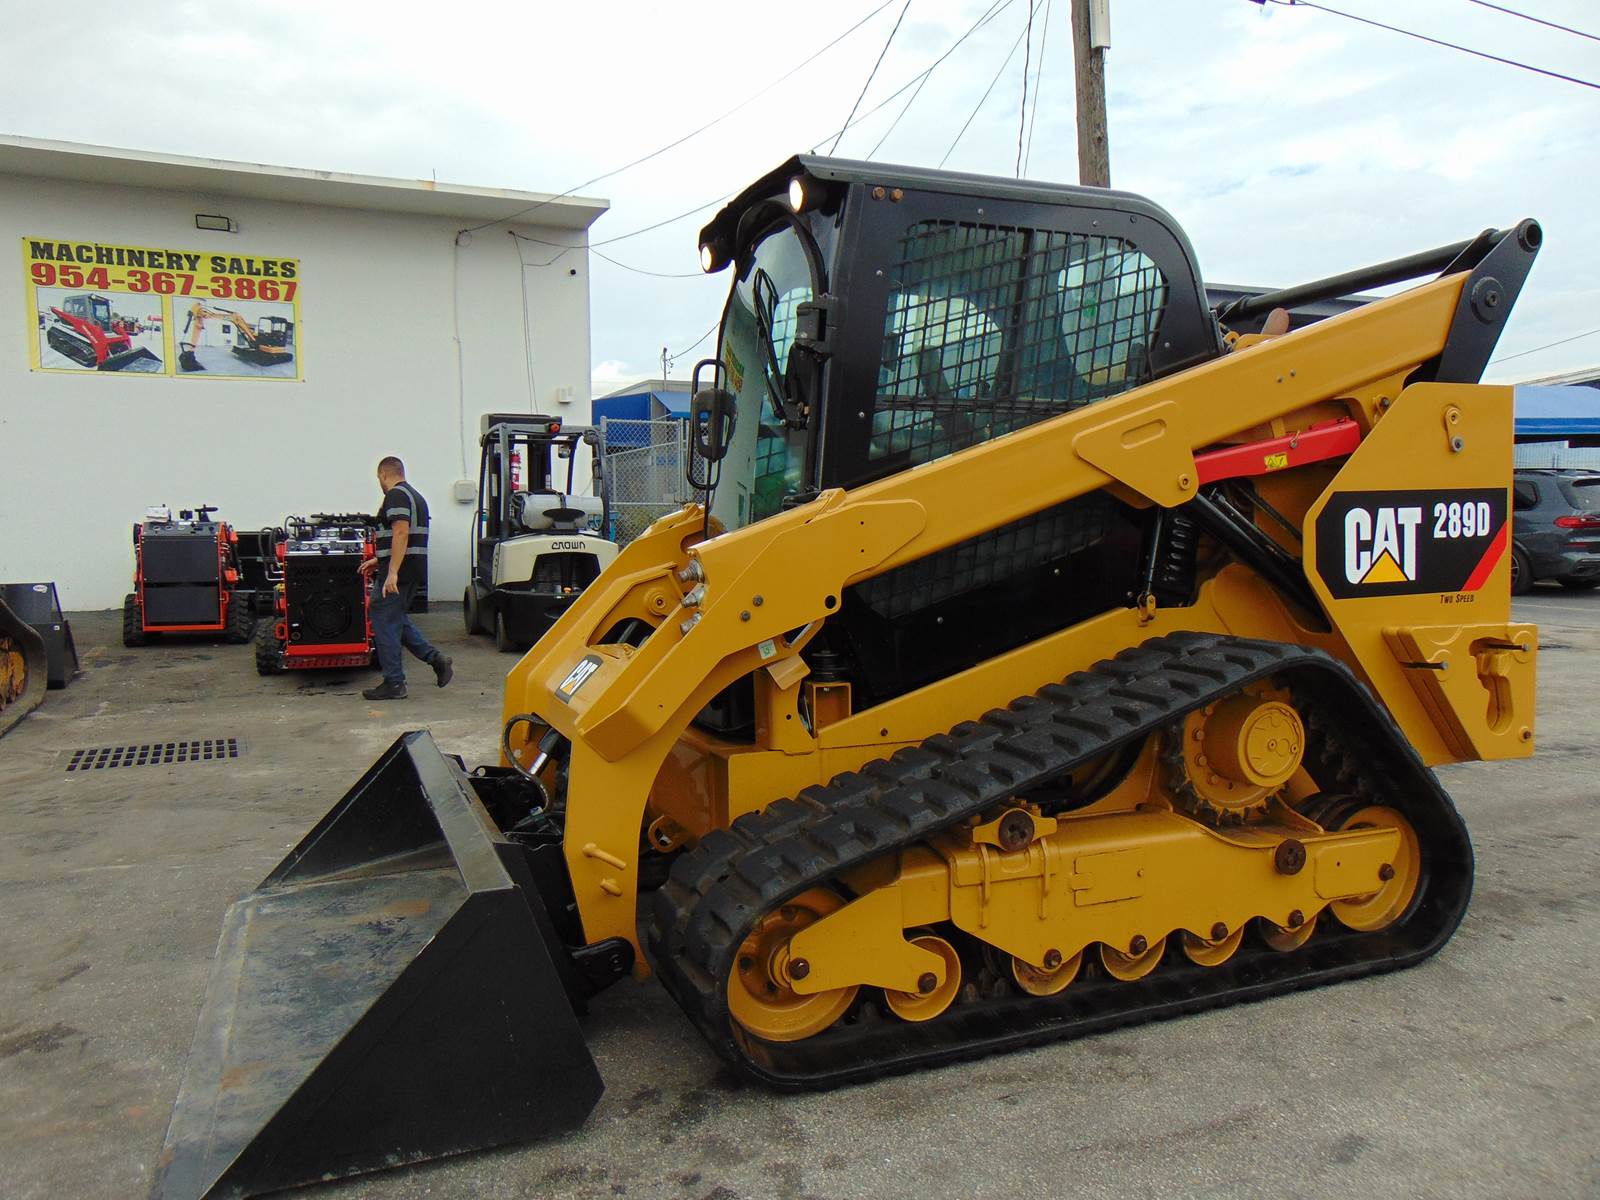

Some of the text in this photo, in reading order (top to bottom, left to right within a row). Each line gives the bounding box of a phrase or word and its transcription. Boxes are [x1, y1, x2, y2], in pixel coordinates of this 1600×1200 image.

[30, 241, 297, 279] MACHINERY SALES
[31, 262, 298, 302] 954-367-3867
[1433, 501, 1491, 539] 289D
[551, 541, 586, 550] CROWN
[1344, 507, 1422, 585] CAT
